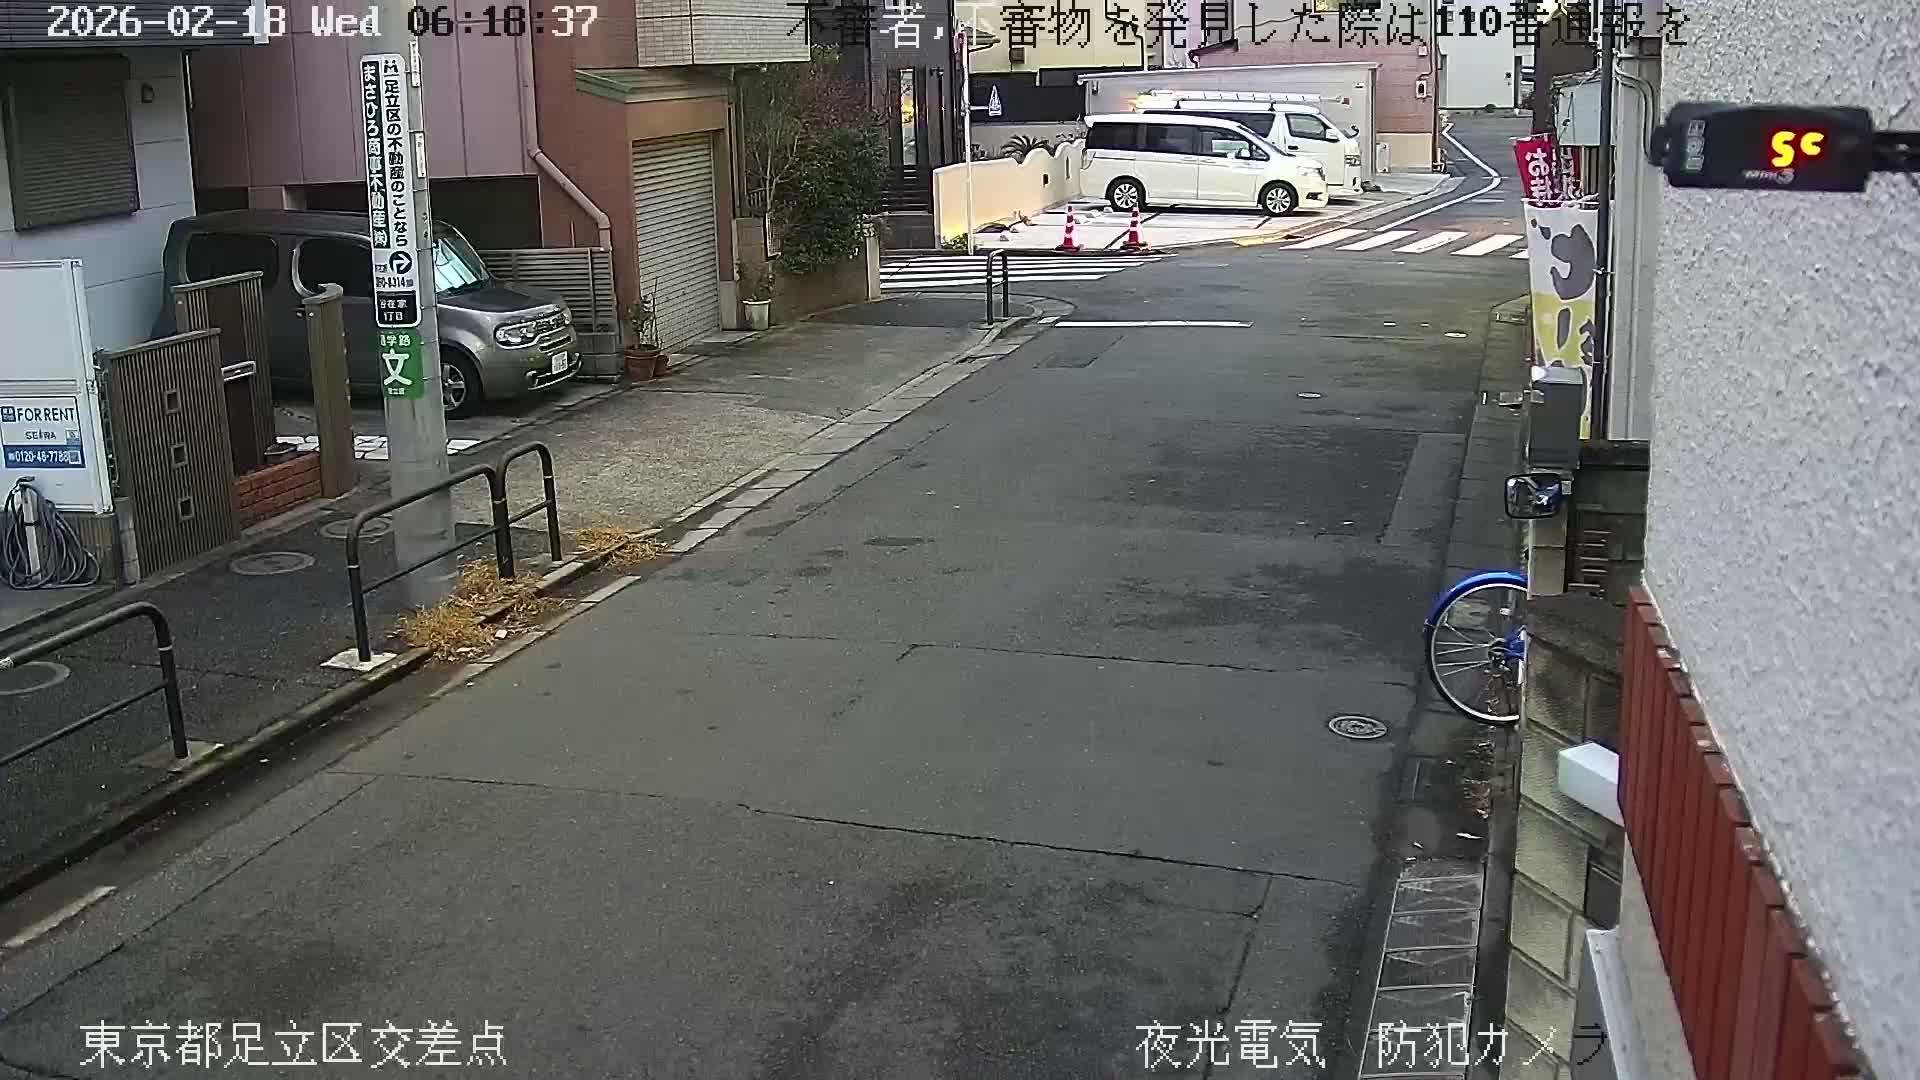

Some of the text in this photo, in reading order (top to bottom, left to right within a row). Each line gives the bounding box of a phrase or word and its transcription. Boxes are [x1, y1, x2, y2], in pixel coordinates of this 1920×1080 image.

[384, 79, 408, 247] 足立区の不動産のことなら
[381, 348, 413, 386] 文
[17, 407, 42, 422] FOR
[44, 407, 75, 422] RENT
